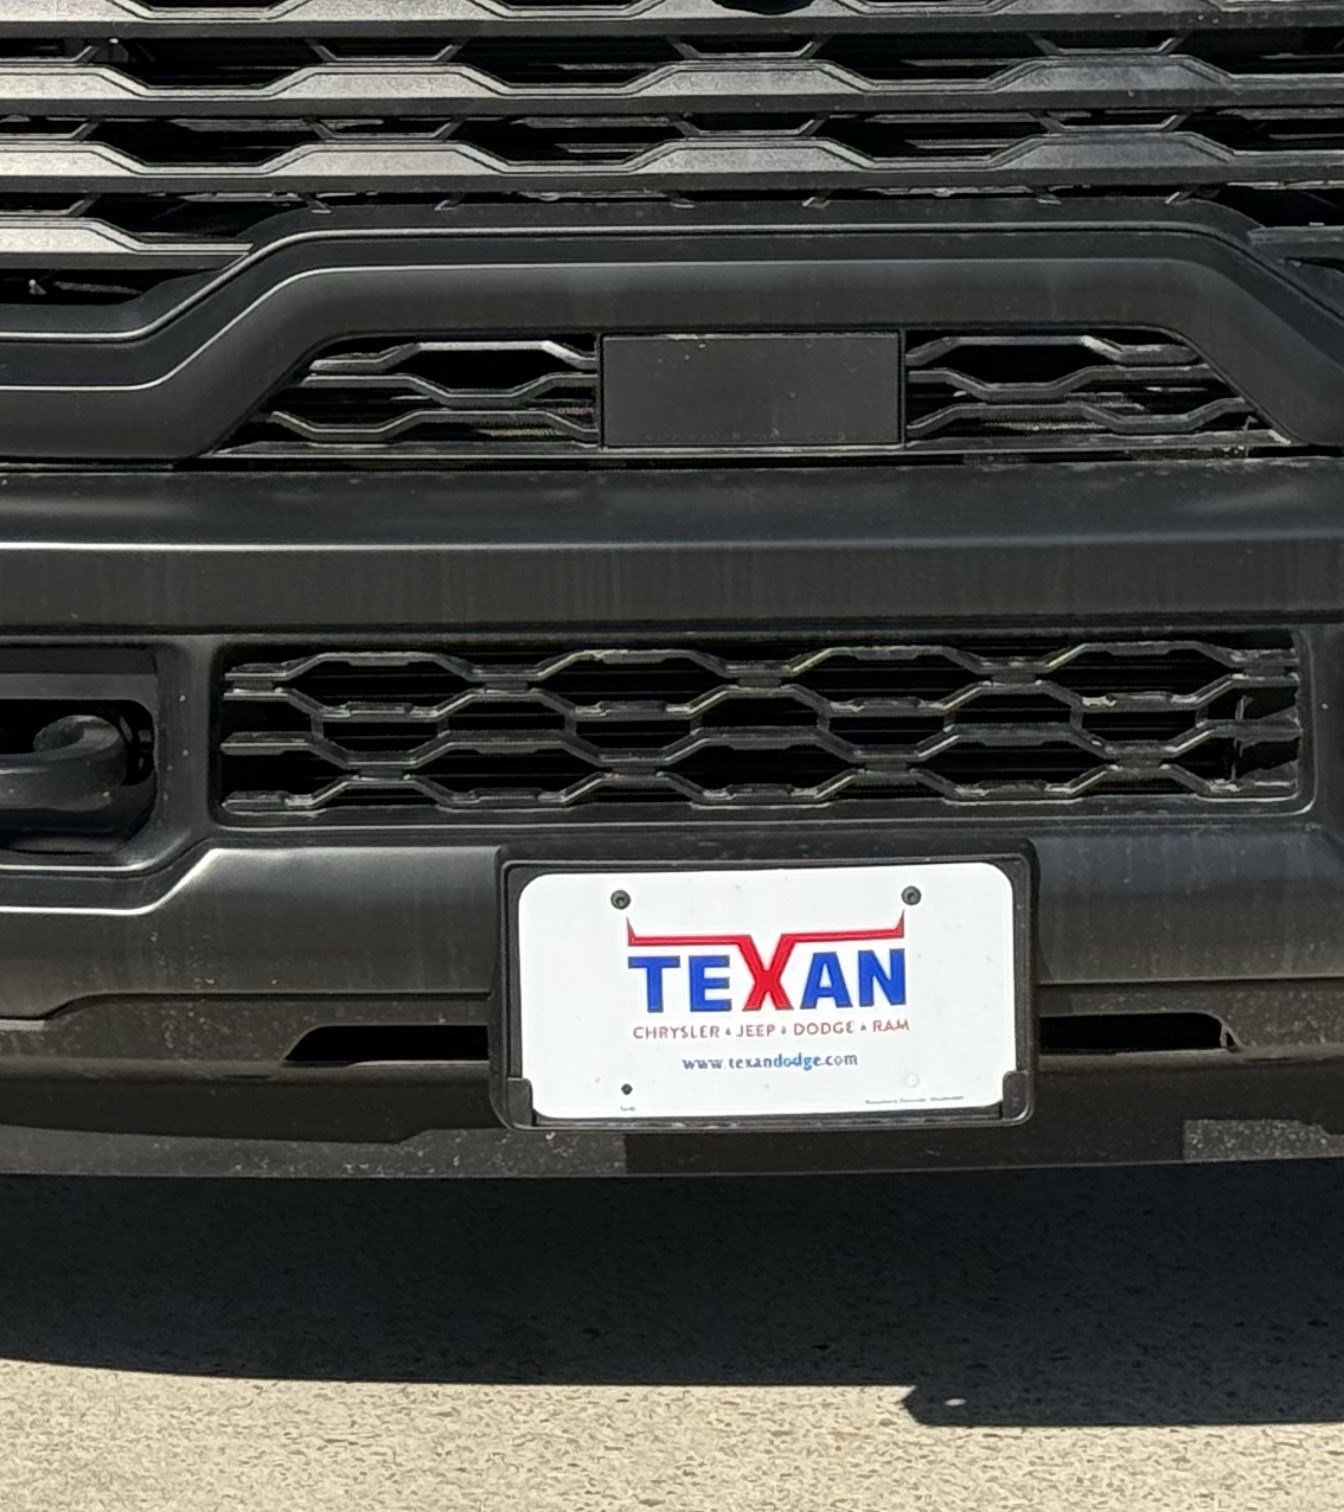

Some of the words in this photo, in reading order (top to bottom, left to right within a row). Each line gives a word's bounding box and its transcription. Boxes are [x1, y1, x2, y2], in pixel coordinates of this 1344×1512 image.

[626, 909, 906, 1014] TEXAN
[632, 1025, 721, 1040] CHRYSLER
[735, 1023, 776, 1038] JEEP
[793, 1021, 855, 1037] DODGE
[872, 1018, 911, 1033] RAM
[683, 1052, 859, 1072] www.texandodge.com
